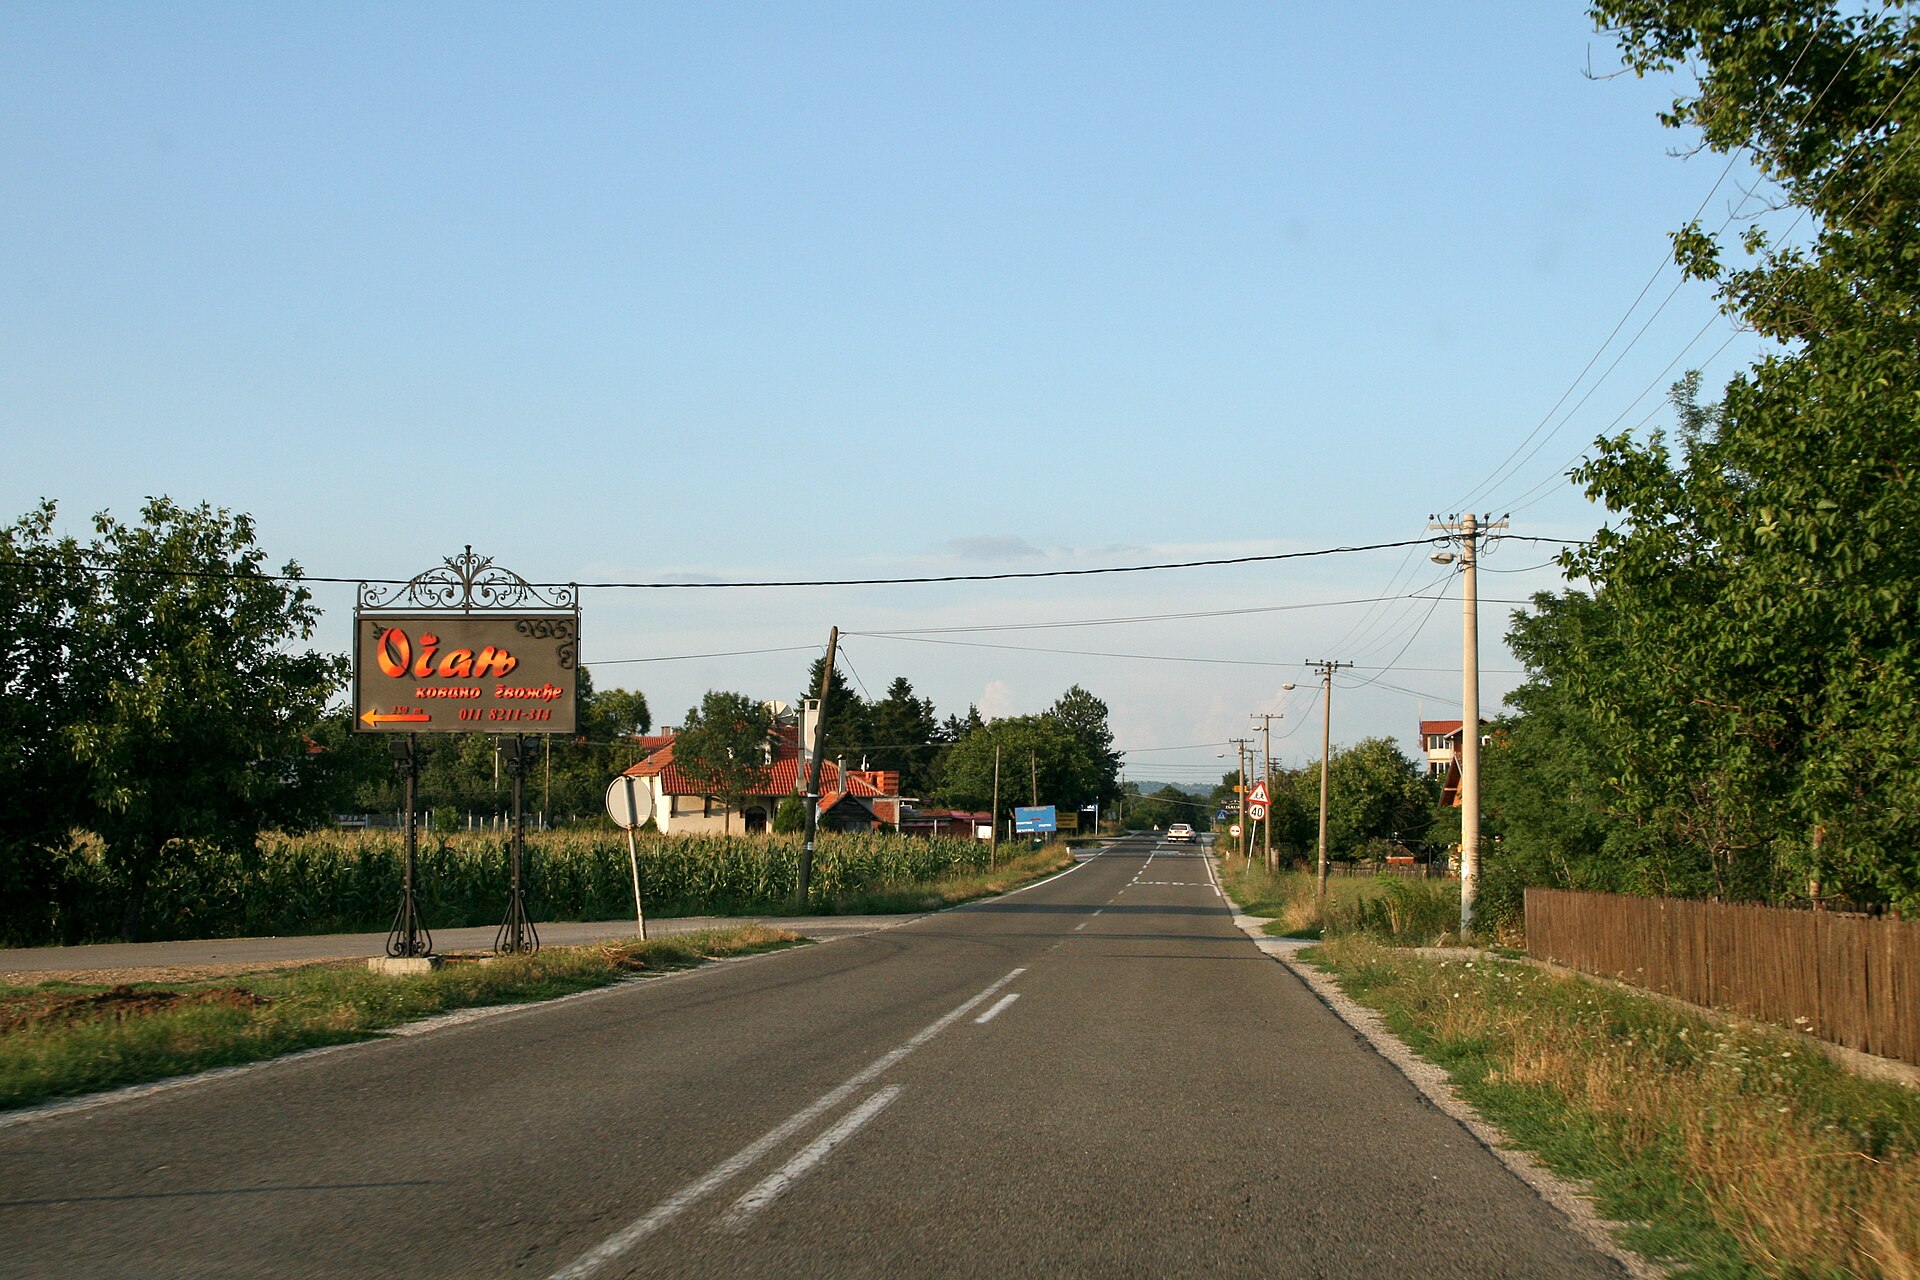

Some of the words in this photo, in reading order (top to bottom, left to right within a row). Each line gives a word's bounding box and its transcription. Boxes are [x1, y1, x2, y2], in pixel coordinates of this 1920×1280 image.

[415, 686, 481, 699] ковано
[458, 708, 483, 721] 011
[488, 708, 552, 721] 8211-314
[1251, 807, 1263, 817] 40
